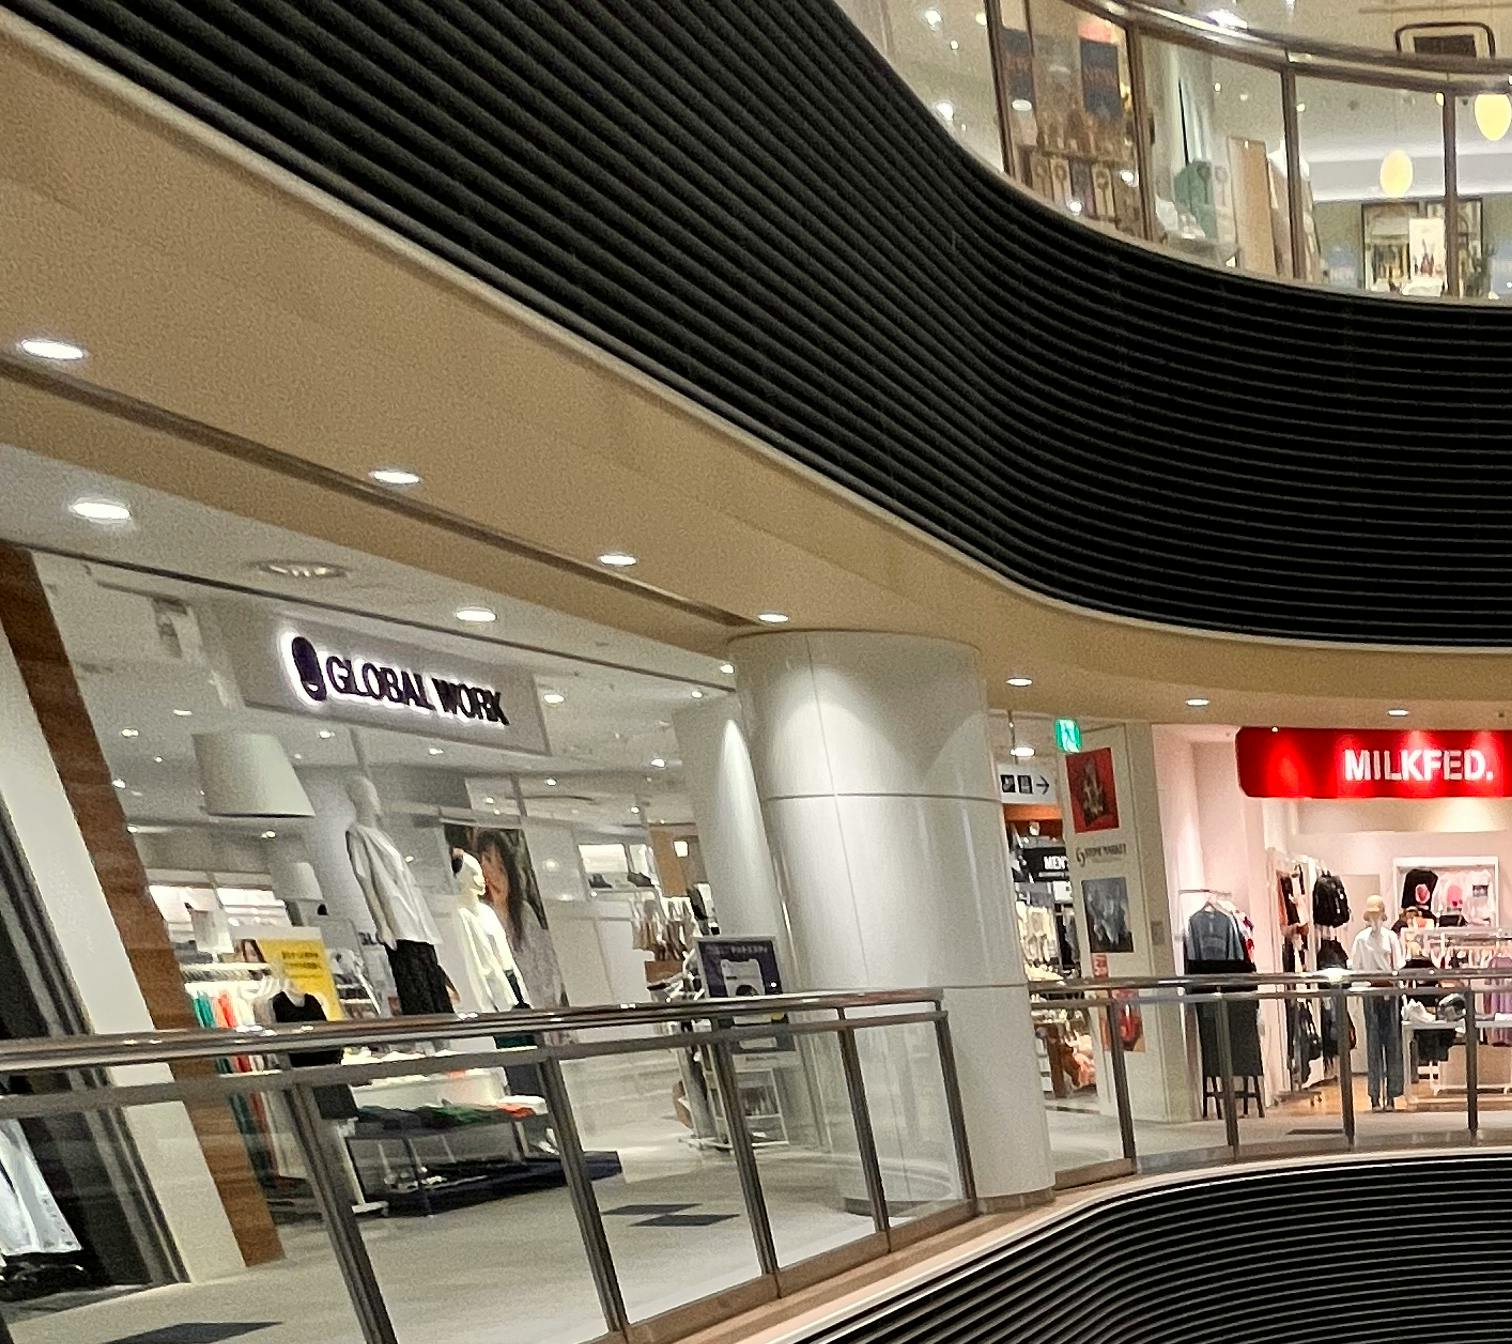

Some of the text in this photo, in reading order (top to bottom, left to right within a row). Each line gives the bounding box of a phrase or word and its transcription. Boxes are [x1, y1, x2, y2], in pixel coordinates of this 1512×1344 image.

[325, 655, 510, 727] GLOBAL WORK
[1344, 749, 1494, 781] MILKFED.
